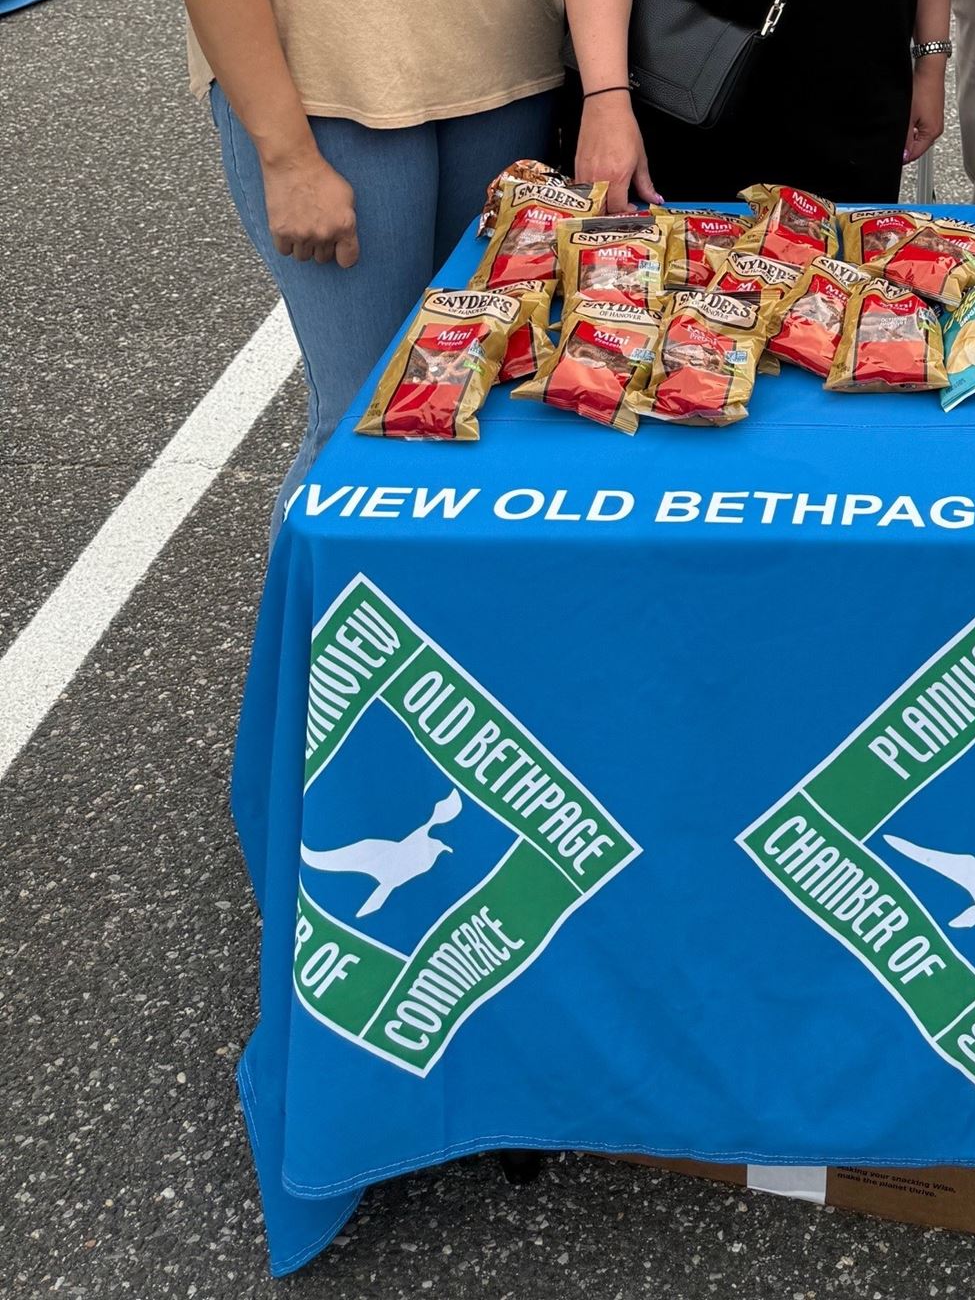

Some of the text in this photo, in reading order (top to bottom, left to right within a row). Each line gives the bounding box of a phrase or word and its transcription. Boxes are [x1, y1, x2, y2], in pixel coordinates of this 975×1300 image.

[518, 185, 586, 210] SNYDER'S
[793, 191, 818, 213] Mini
[525, 209, 558, 222] Mini
[701, 222, 733, 231] Mini
[598, 248, 632, 258] Mini
[731, 253, 798, 281] SNYDER'S
[820, 259, 872, 286] SNYD
[433, 295, 513, 314] SNYDER'S
[609, 311, 641, 320] HANOVER
[437, 328, 473, 341] Mini
[593, 330, 631, 345] Mini
[283, 484, 481, 520] VIEW
[492, 487, 634, 523] OLD
[305, 600, 401, 760] INVIEW
[403, 671, 615, 876] OLD BETHPAGE
[763, 815, 947, 985] CHAMBER OF
[301, 942, 360, 999] OF
[384, 906, 525, 1052] COMMERCE
[837, 1165, 868, 1176] aking
[870, 1171, 890, 1180] your
[891, 1175, 930, 1189] snacking
[837, 1172, 937, 1198] make the planet thrive.
